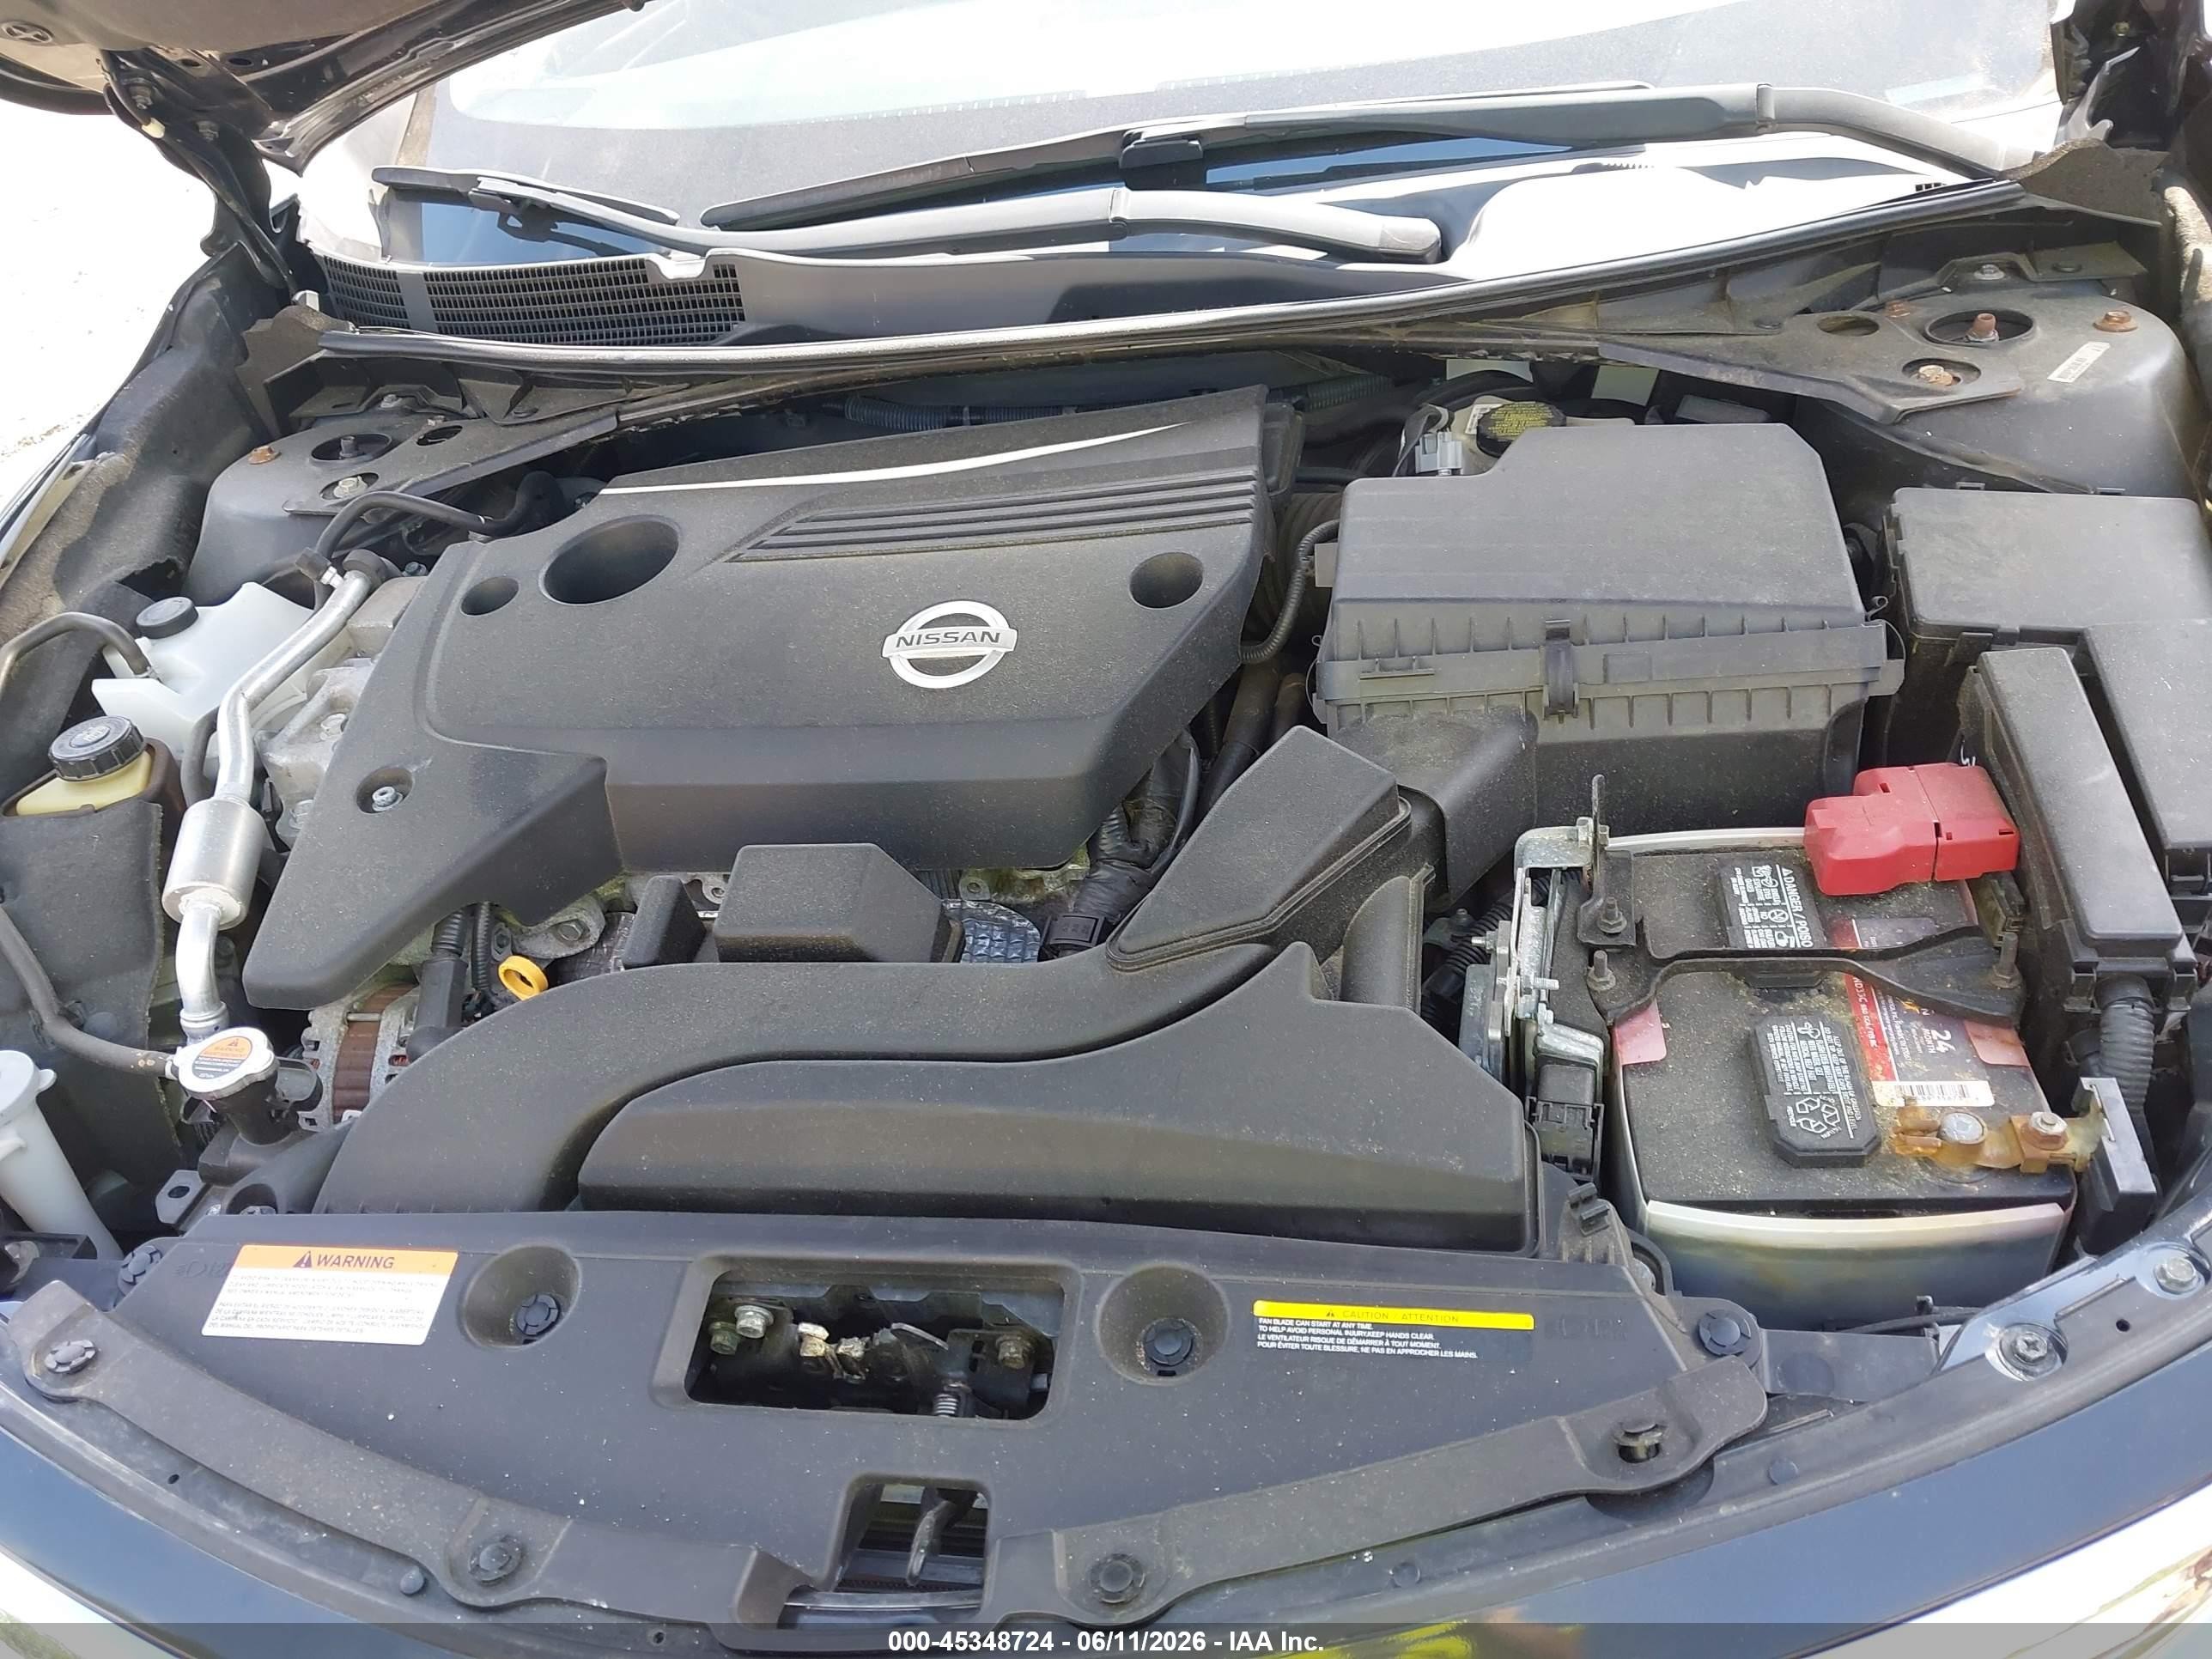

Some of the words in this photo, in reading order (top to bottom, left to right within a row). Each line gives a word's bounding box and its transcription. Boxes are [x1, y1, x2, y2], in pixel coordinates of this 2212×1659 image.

[896, 631, 1000, 648] NISSAN
[1784, 878, 1803, 912] DANGER
[1796, 920, 1814, 948] POISO
[1922, 1028, 1937, 1054] MONTH
[1930, 1030, 1956, 1054] 24
[316, 1254, 395, 1269] WARNING
[1342, 1310, 1389, 1320] CAUTION
[1401, 1313, 1458, 1323] ATTENTION
